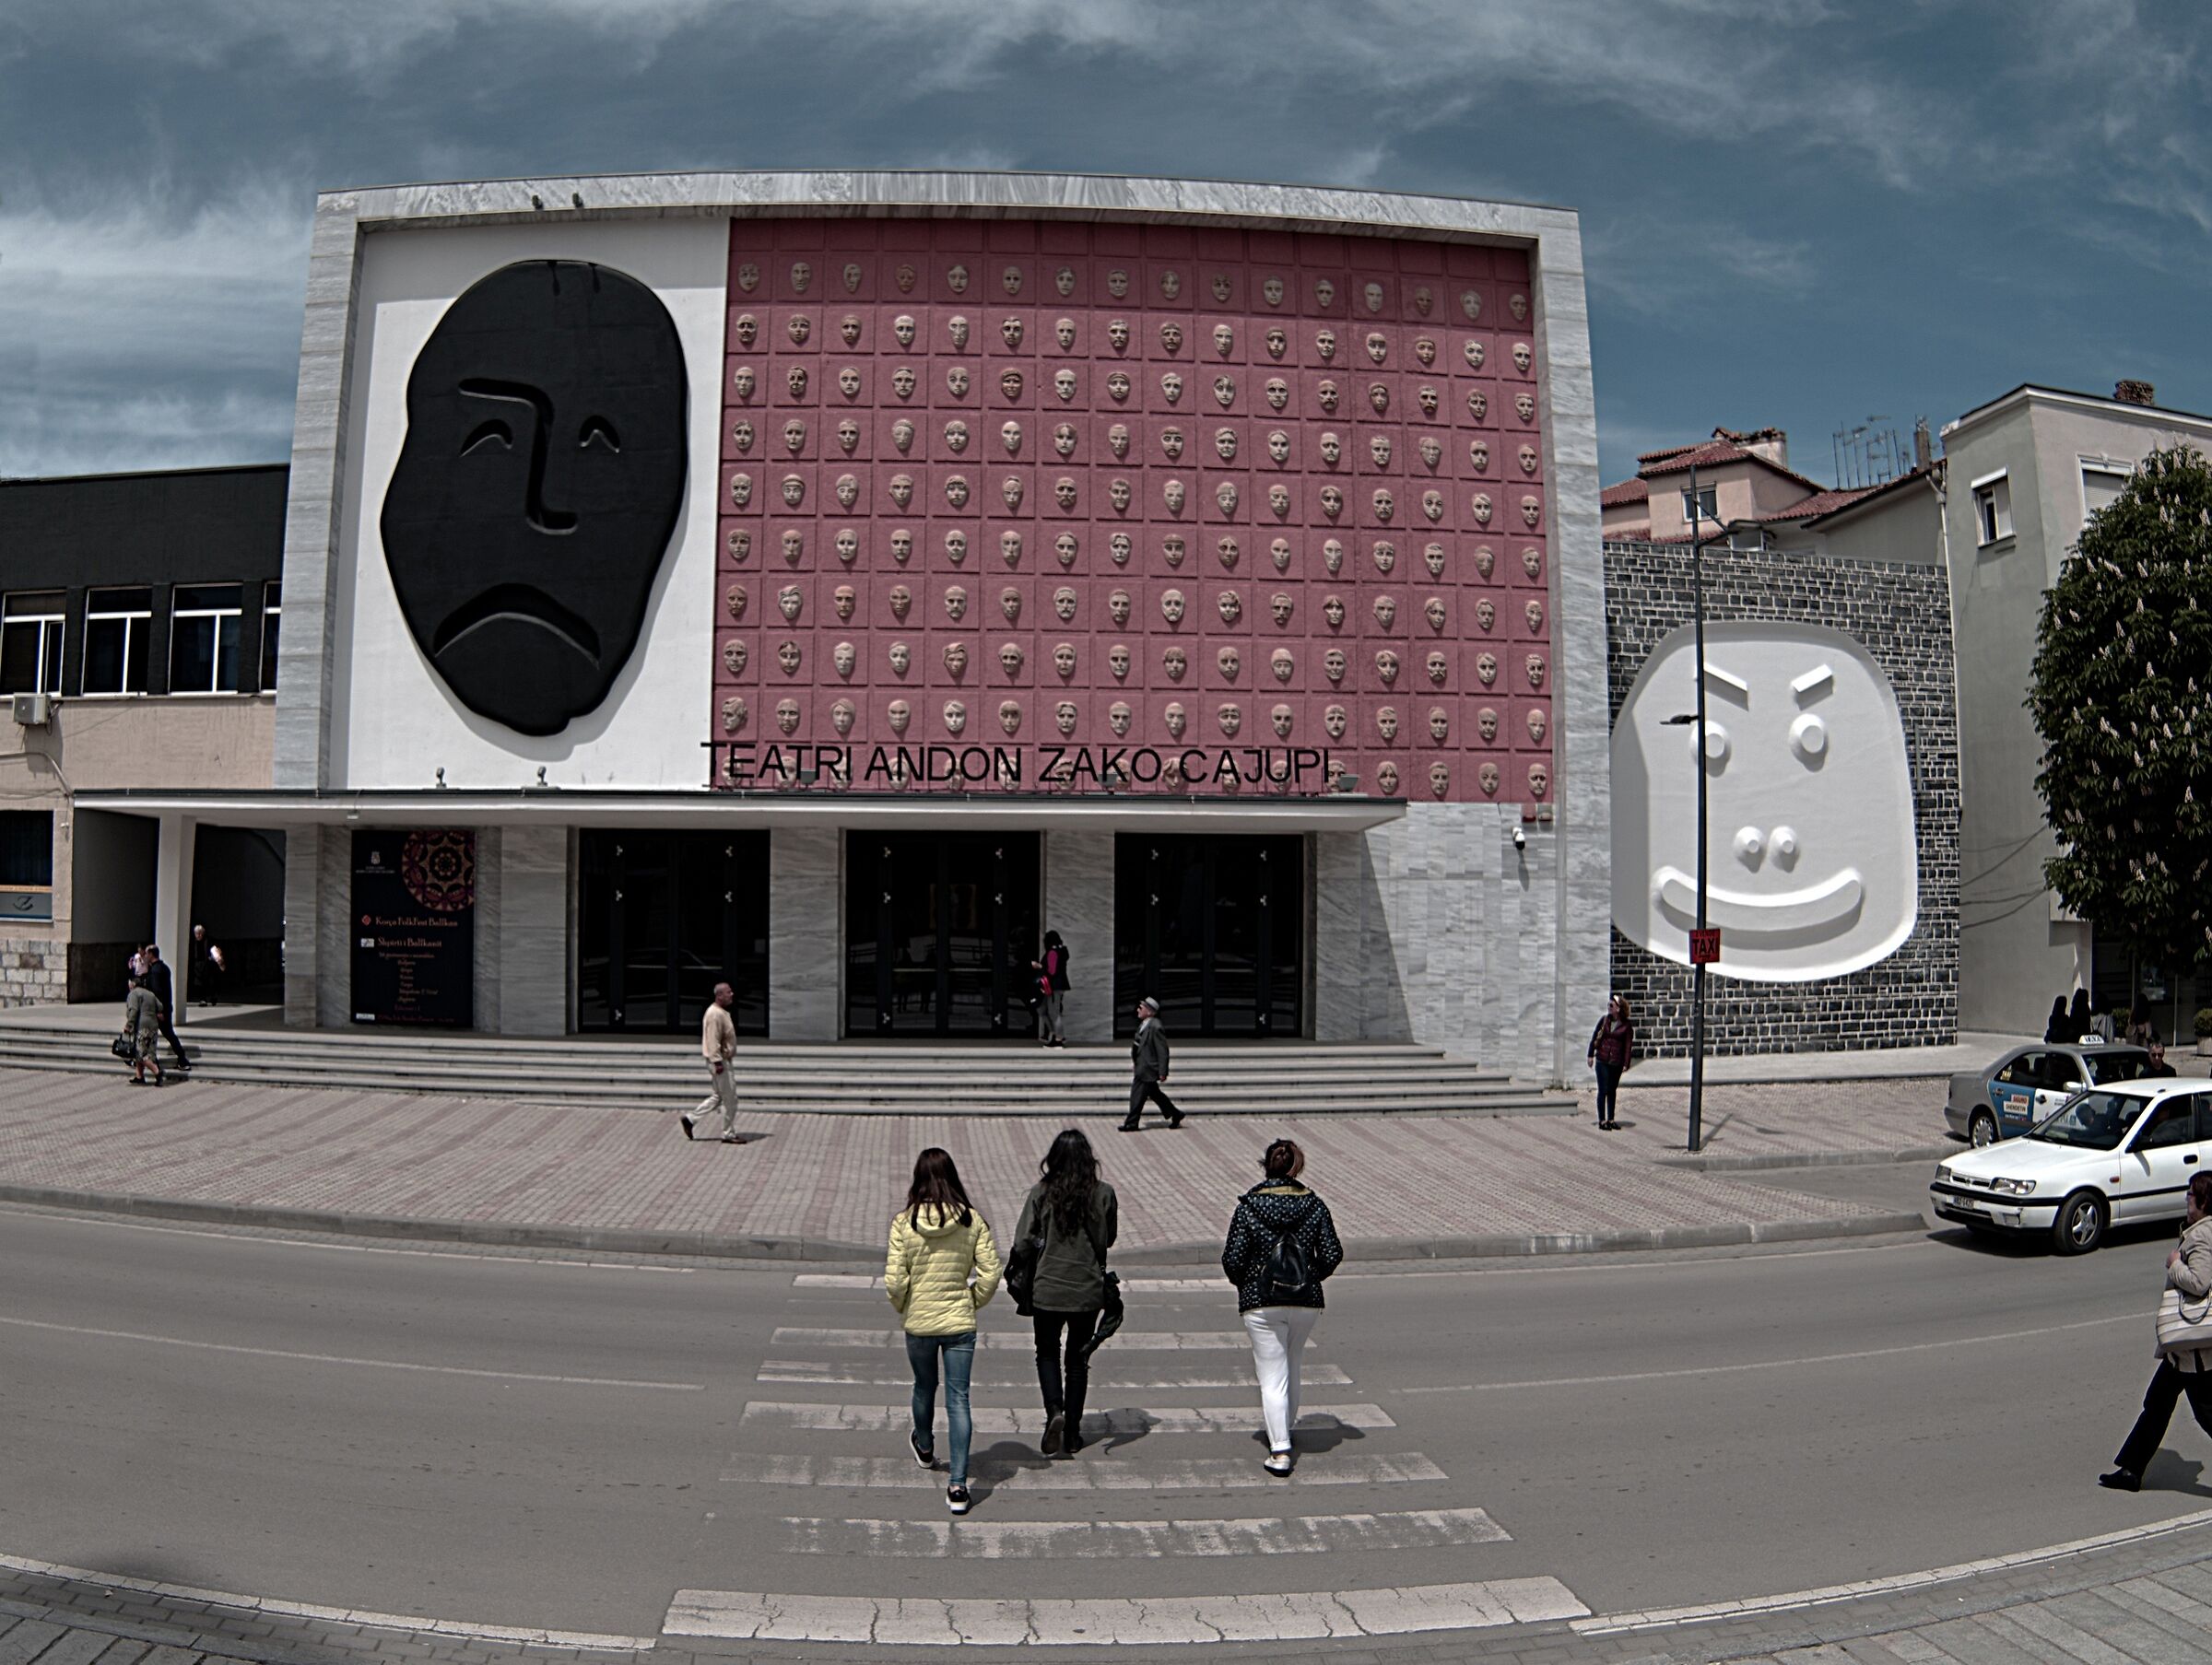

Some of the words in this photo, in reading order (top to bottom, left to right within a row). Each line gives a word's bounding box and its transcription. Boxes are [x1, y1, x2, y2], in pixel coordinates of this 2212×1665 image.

[701, 743, 852, 780] TEATRI
[864, 745, 1022, 783] ANDON
[1039, 746, 1163, 783] ZAKO
[1179, 748, 1329, 784] CAJUPI
[1692, 937, 1719, 955] TAXI
